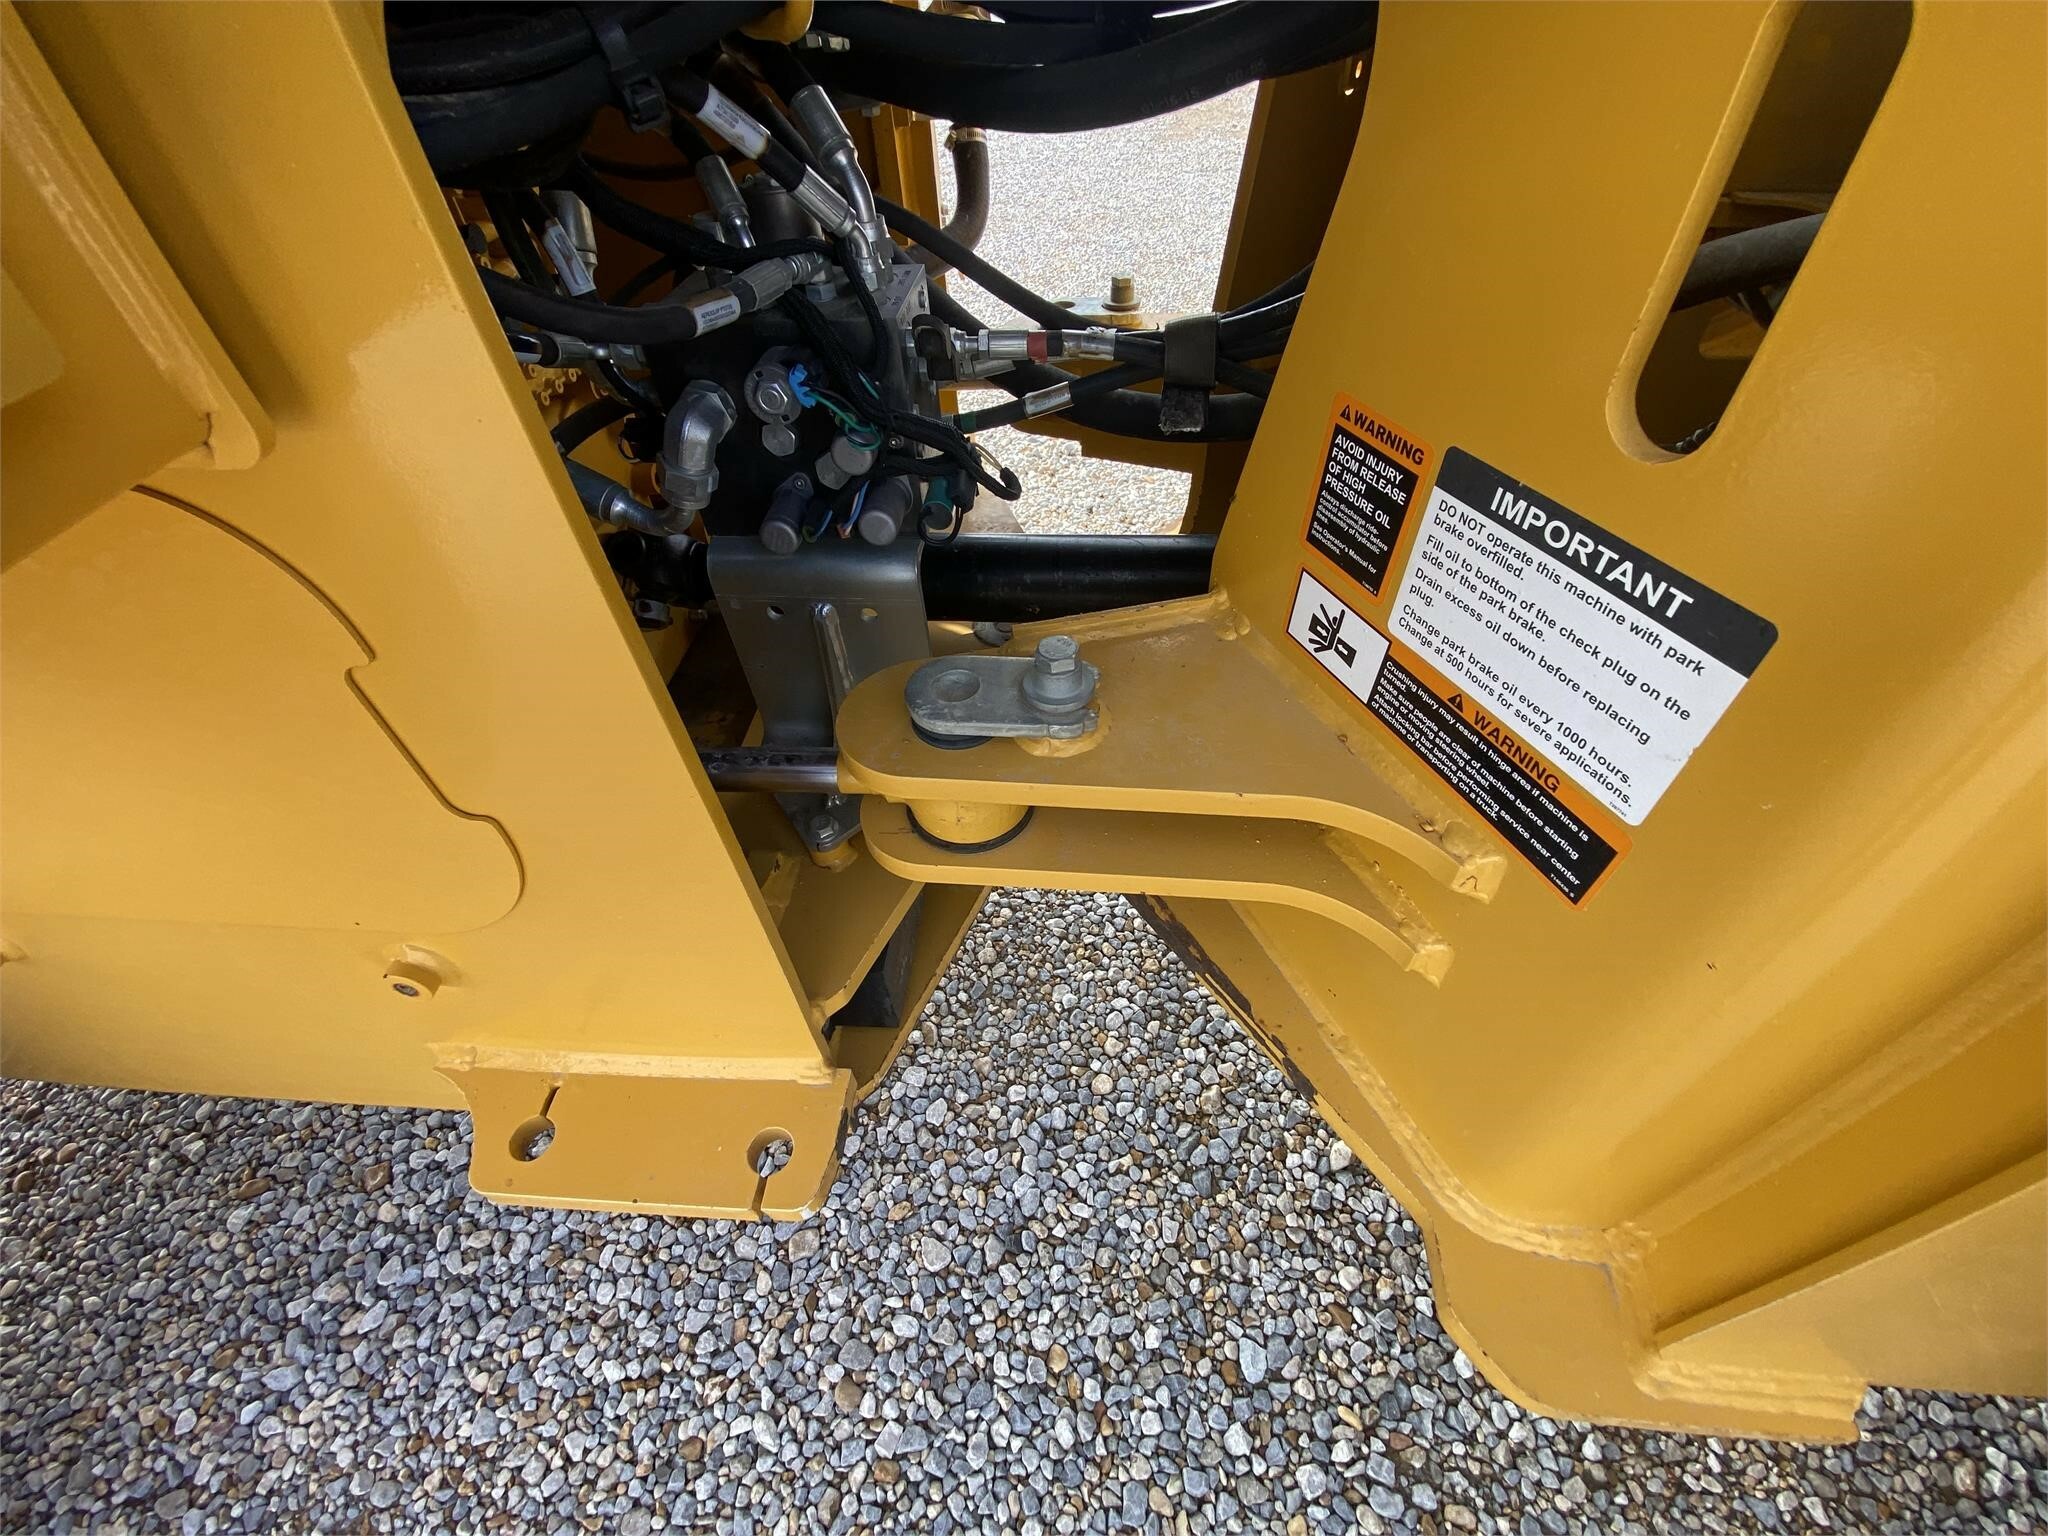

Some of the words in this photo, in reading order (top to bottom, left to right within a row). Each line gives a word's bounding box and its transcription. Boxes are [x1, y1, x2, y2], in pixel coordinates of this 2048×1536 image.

[1334, 434, 1365, 461] AVOID
[1365, 453, 1404, 485] INJURY
[1353, 409, 1425, 466] WARNING
[1324, 473, 1375, 517] PRESSURE
[1374, 509, 1391, 530] OIL
[1328, 461, 1343, 476] OF
[1342, 469, 1367, 495] HIGH
[1331, 446, 1360, 474] FROM
[1359, 465, 1407, 506] RELEASE
[1311, 527, 1341, 556] instructions.
[1315, 510, 1329, 525] lines.
[1317, 504, 1349, 532] disassembly
[1348, 527, 1356, 536] of
[1354, 531, 1381, 555] hydraulic
[1319, 497, 1338, 514] control
[1337, 510, 1371, 538] accumulator
[1369, 533, 1388, 552] before
[1321, 489, 1340, 507] Always
[1339, 503, 1366, 526] discharge
[1365, 523, 1379, 535] ride-
[1433, 512, 1465, 541] brake
[1466, 537, 1524, 581] overfilled.
[1313, 520, 1323, 533] See
[1322, 528, 1349, 553] Operator's
[1348, 548, 1369, 568] Manual
[1367, 563, 1377, 574] for
[1490, 486, 1695, 619] IMPORTANT
[1408, 584, 1434, 608] plug.
[1421, 550, 1444, 571] side
[1445, 567, 1460, 580] of
[1459, 574, 1478, 594] the
[1477, 590, 1507, 614] park
[1507, 607, 1545, 643] brake.
[1438, 498, 1458, 519] DO
[1458, 511, 1487, 536] NOT
[1486, 532, 1534, 567] operate
[1535, 561, 1562, 585] this
[1563, 580, 1626, 626] machine
[1629, 621, 1663, 650] with
[1663, 646, 1705, 677] park
[1414, 566, 1443, 594] Drain
[1444, 590, 1483, 622] excess
[1485, 619, 1502, 635] oil
[1502, 631, 1536, 661] down
[1537, 655, 1581, 693] before
[1582, 690, 1651, 746] replacing
[1426, 533, 1445, 553] Fill
[1444, 549, 1461, 564] oil
[1460, 557, 1473, 573] to
[1474, 566, 1518, 603] bottom
[1519, 599, 1537, 614] of
[1535, 607, 1557, 630] the
[1559, 626, 1601, 660] check
[1601, 656, 1638, 687] plug
[1639, 682, 1661, 701] on
[1663, 696, 1691, 721] the
[1383, 668, 1407, 693] turned.
[1398, 616, 1433, 649] Change
[1433, 645, 1445, 658] at
[1445, 652, 1464, 672] 500
[1464, 667, 1495, 697] hours
[1496, 692, 1514, 710] for
[1513, 708, 1553, 742] severe
[1553, 740, 1632, 808] applications.
[1403, 604, 1441, 638] Change
[1440, 635, 1467, 659] park
[1467, 652, 1500, 683] brake
[1501, 681, 1518, 697] oil
[1518, 694, 1554, 725] every
[1557, 721, 1588, 750] 1000
[1588, 746, 1632, 788] hours.
[1371, 700, 1380, 710] of
[1378, 707, 1407, 735] machine
[1406, 733, 1416, 743] or
[1415, 740, 1459, 784] transporting
[1458, 781, 1470, 794] on
[1469, 792, 1476, 800] a
[1475, 796, 1498, 821] truck.
[1377, 685, 1400, 708] engine
[1399, 705, 1409, 715] or
[1408, 712, 1435, 741] moving
[1434, 737, 1466, 768] steering
[1465, 764, 1490, 790] wheel.
[1379, 676, 1398, 697] Make
[1397, 694, 1414, 711] sure
[1412, 708, 1439, 733] people
[1438, 730, 1452, 744] are
[1451, 742, 1472, 761] clear
[1470, 759, 1482, 770] of
[1480, 767, 1516, 801] machine
[1515, 798, 1544, 827] before
[1543, 825, 1579, 861] starting
[1386, 661, 1418, 693] Crushing
[1417, 687, 1439, 710] injury
[1438, 707, 1456, 725] may
[1455, 722, 1479, 745] result
[1478, 741, 1488, 753] in
[1487, 749, 1512, 773] hinge
[1511, 771, 1532, 791] area
[1531, 787, 1541, 797] if
[1538, 795, 1579, 833] machine
[1578, 829, 1589, 842] is
[1473, 709, 1561, 794] WARNING
[1373, 693, 1396, 716] Attach
[1395, 712, 1421, 740] locking
[1420, 735, 1434, 749] bar
[1432, 746, 1458, 772] before
[1456, 770, 1500, 813] performing
[1499, 809, 1530, 840] service
[1530, 838, 1552, 858] near
[1550, 857, 1581, 885] center
